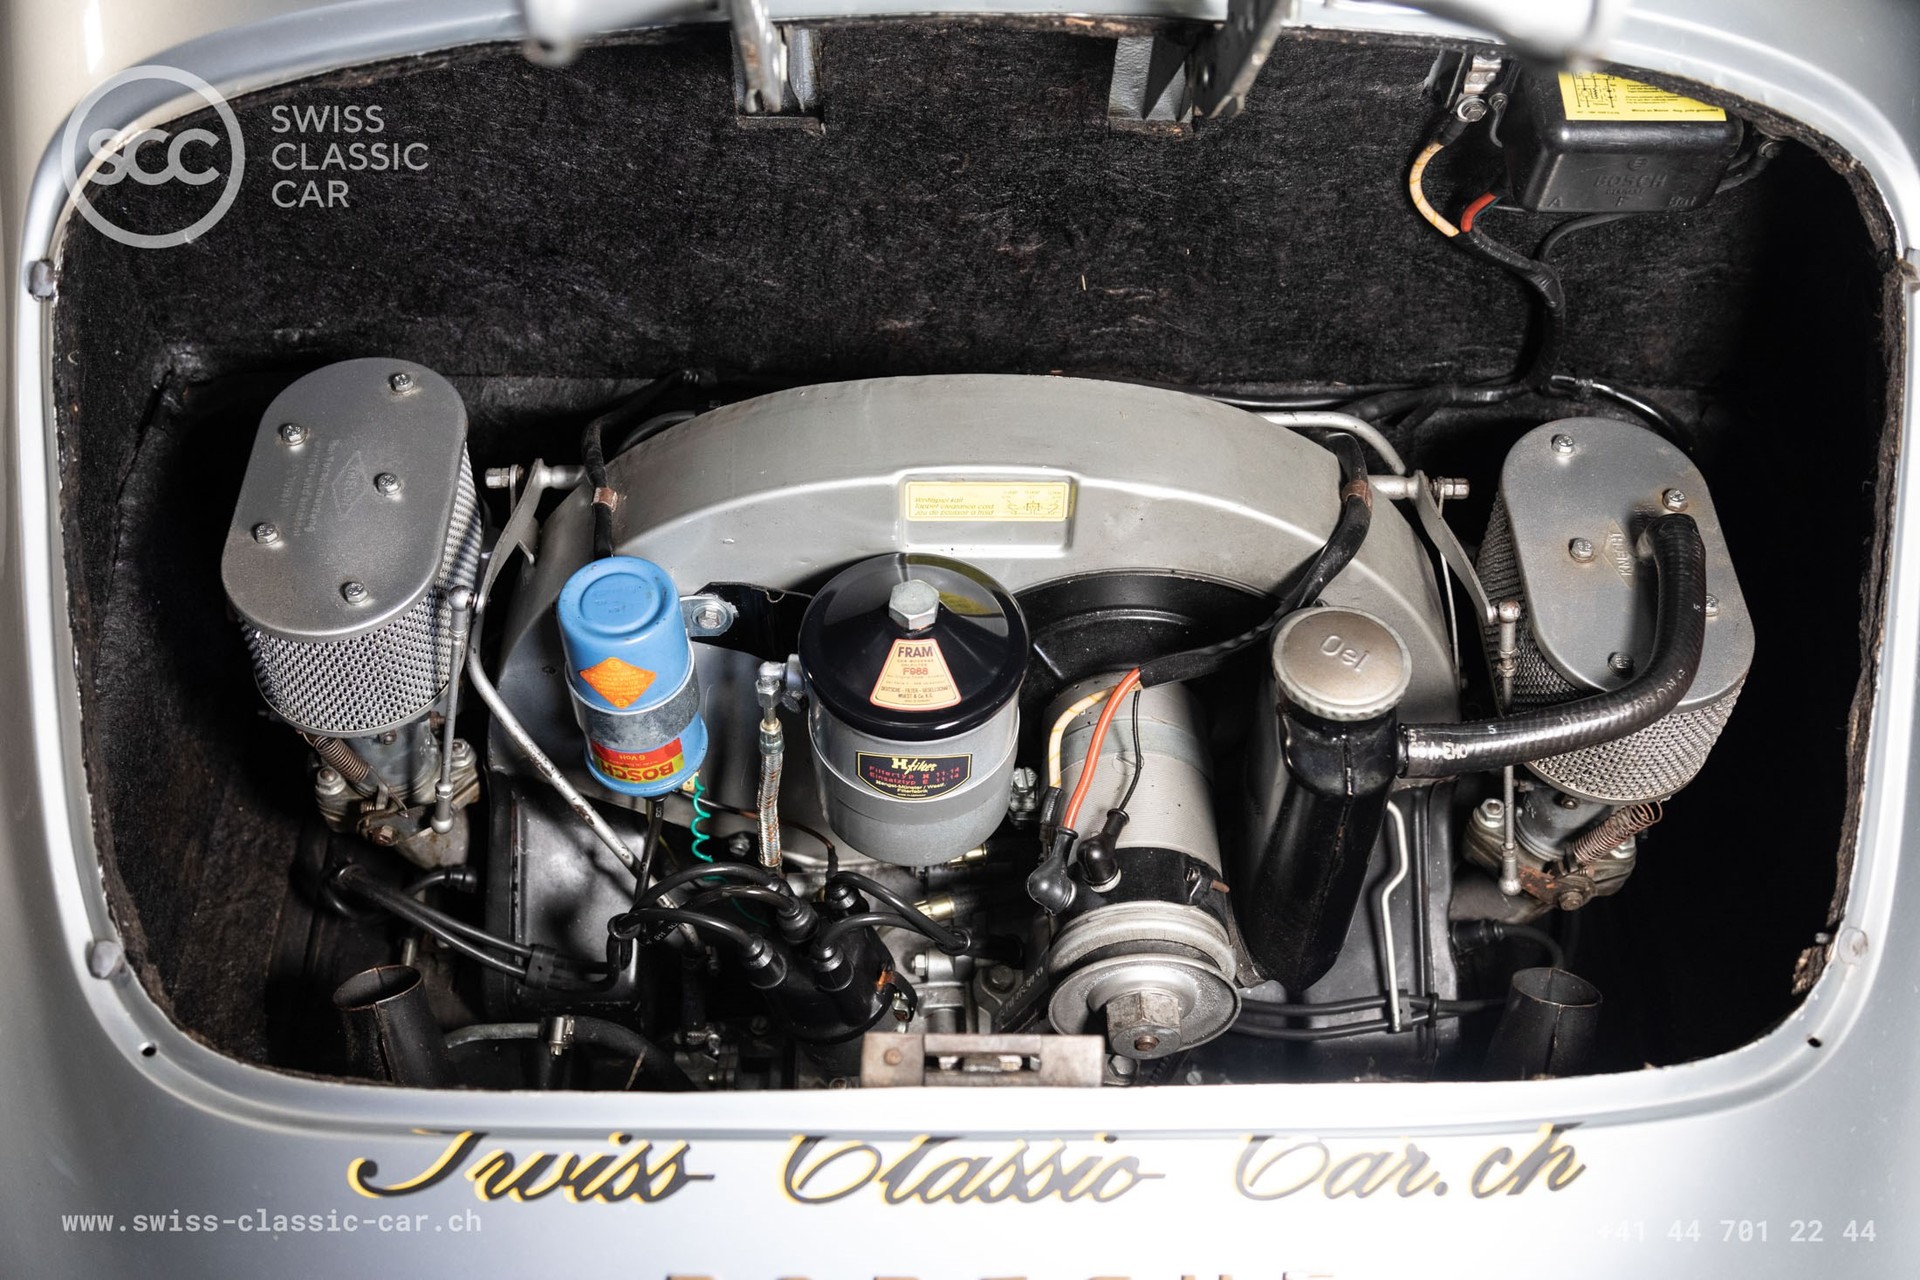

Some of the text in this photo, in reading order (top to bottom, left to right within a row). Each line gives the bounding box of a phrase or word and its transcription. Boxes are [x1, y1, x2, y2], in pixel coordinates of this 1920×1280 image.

[1594, 174, 1668, 188] BOSCH
[897, 646, 934, 658] FRAM
[1321, 635, 1370, 672] Oel
[600, 761, 675, 782] BOSCH
[869, 765, 914, 779] Filtertyp
[869, 771, 916, 785] Einsatztyp
